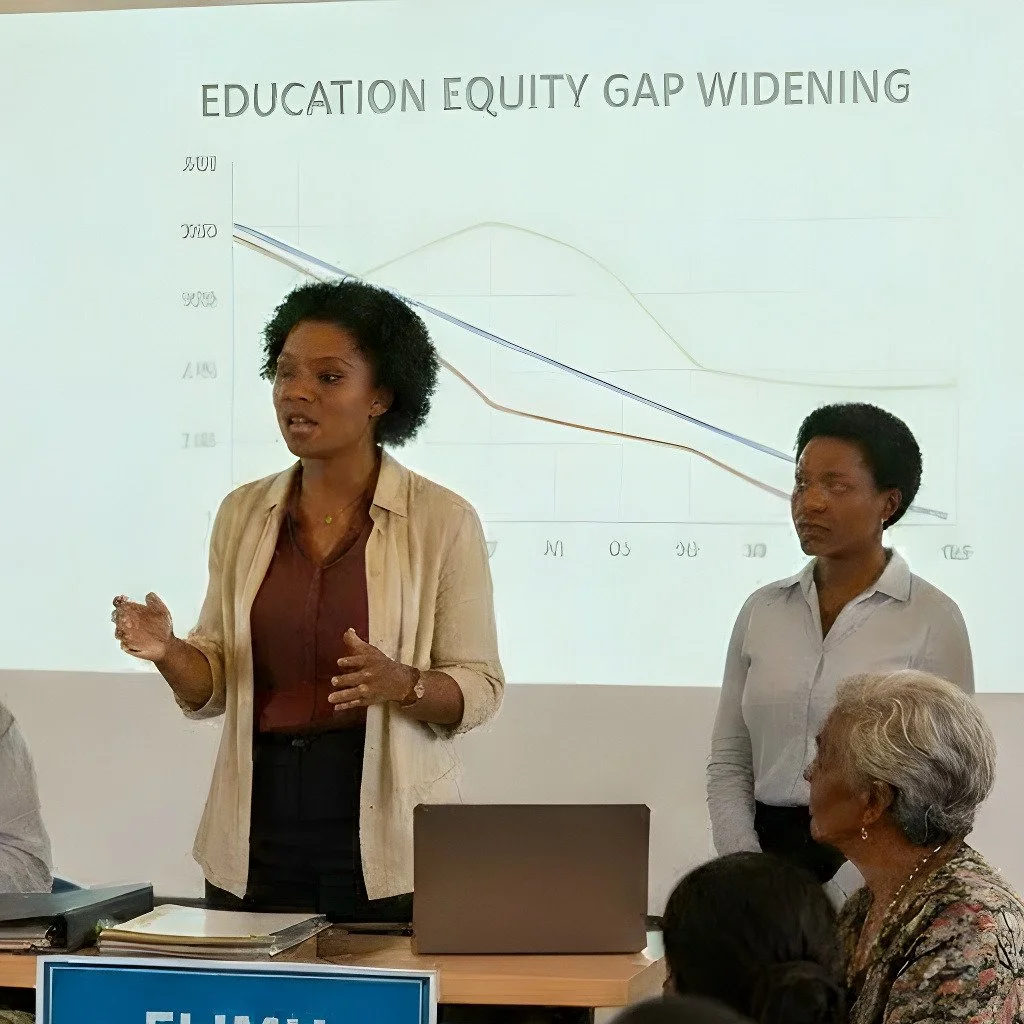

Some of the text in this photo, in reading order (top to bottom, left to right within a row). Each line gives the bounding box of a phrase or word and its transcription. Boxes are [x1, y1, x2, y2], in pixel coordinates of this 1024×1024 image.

[201, 68, 911, 119] EDUCATION EQUITY GAP WIDENING
